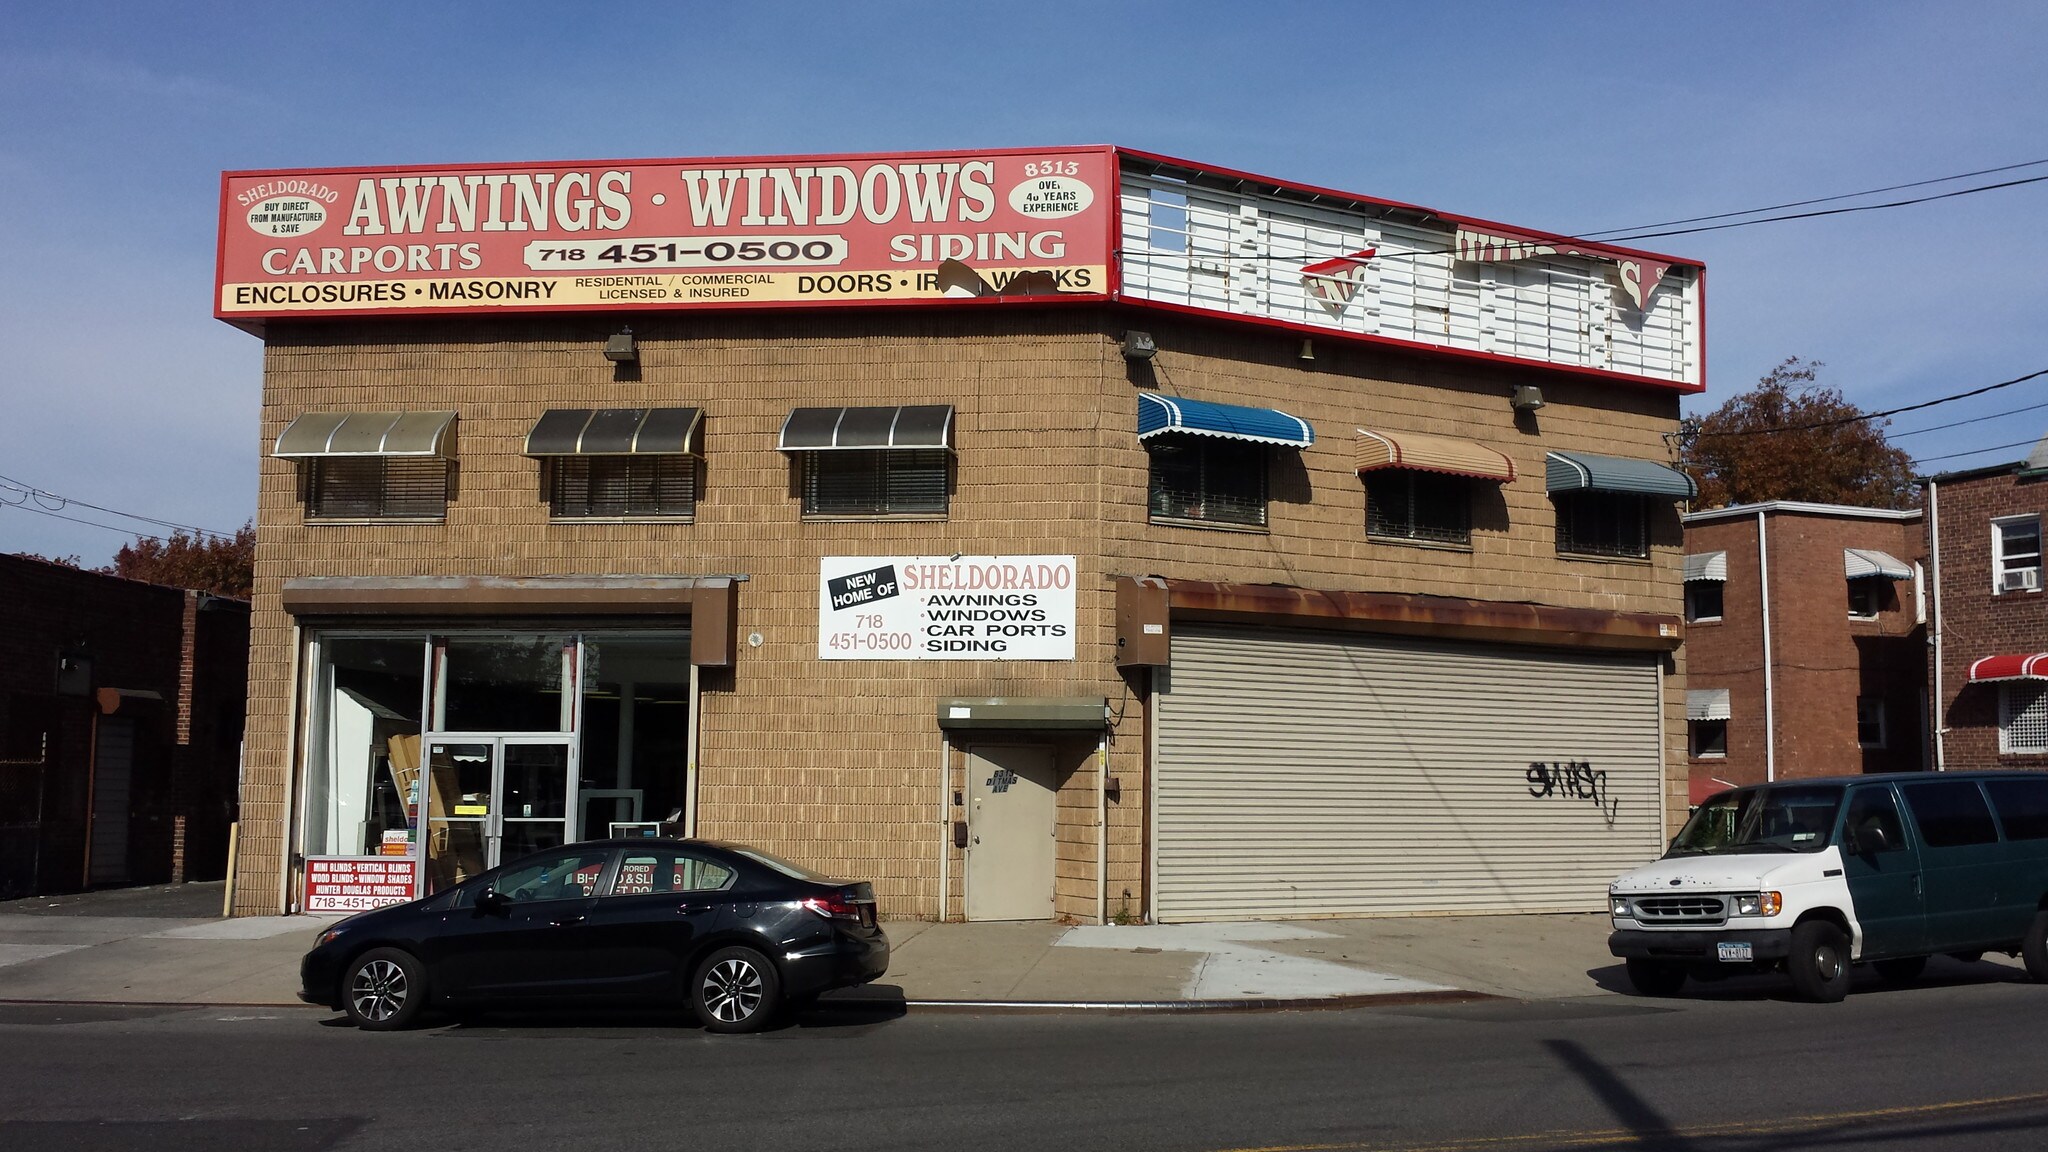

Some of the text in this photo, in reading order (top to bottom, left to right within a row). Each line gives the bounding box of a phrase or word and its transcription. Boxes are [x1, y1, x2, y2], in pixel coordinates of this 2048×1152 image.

[1024, 160, 1079, 177] 8313
[237, 180, 338, 206] SHELDORADO
[343, 161, 996, 236] AWNINGS WINDOWS
[1043, 191, 1076, 201] YEARS
[264, 201, 310, 212] BUY DIRECT
[1023, 202, 1079, 213] EXPERIENCE
[250, 212, 323, 223] FROM MANUFACTURER
[271, 224, 300, 233] & SAVE
[261, 230, 1066, 275] CARPORTS 718 451-0500 SIDING
[575, 276, 663, 288] RESIDENTIAL
[681, 274, 776, 286] COMMERCIAL
[798, 273, 892, 294] DOORS
[992, 268, 1091, 289] WKS
[235, 280, 558, 304] ENCLOSURES MASONRY
[599, 287, 750, 300] LICENSED & INSURED
[845, 572, 877, 590] NEW
[903, 564, 1071, 591] SHELDORADO
[833, 582, 896, 607] HOME OF
[926, 594, 1038, 607] AWNINGS
[855, 614, 883, 629] 718
[927, 609, 1046, 622] WINDOWS
[926, 624, 1067, 637] CAR PORTS
[829, 632, 912, 650] 451-0500
[926, 640, 1008, 652] SIDING
[986, 777, 1018, 786] DITMAS
[992, 784, 1009, 793] AVE
[313, 863, 411, 873] MINI BLINDS VERTICAL BLINDS
[311, 873, 413, 884] WOOD BLINDS WINDOW SHADES
[625, 873, 634, 884] &
[315, 885, 406, 895] HUNTER DOUGLAS PRODUCTS
